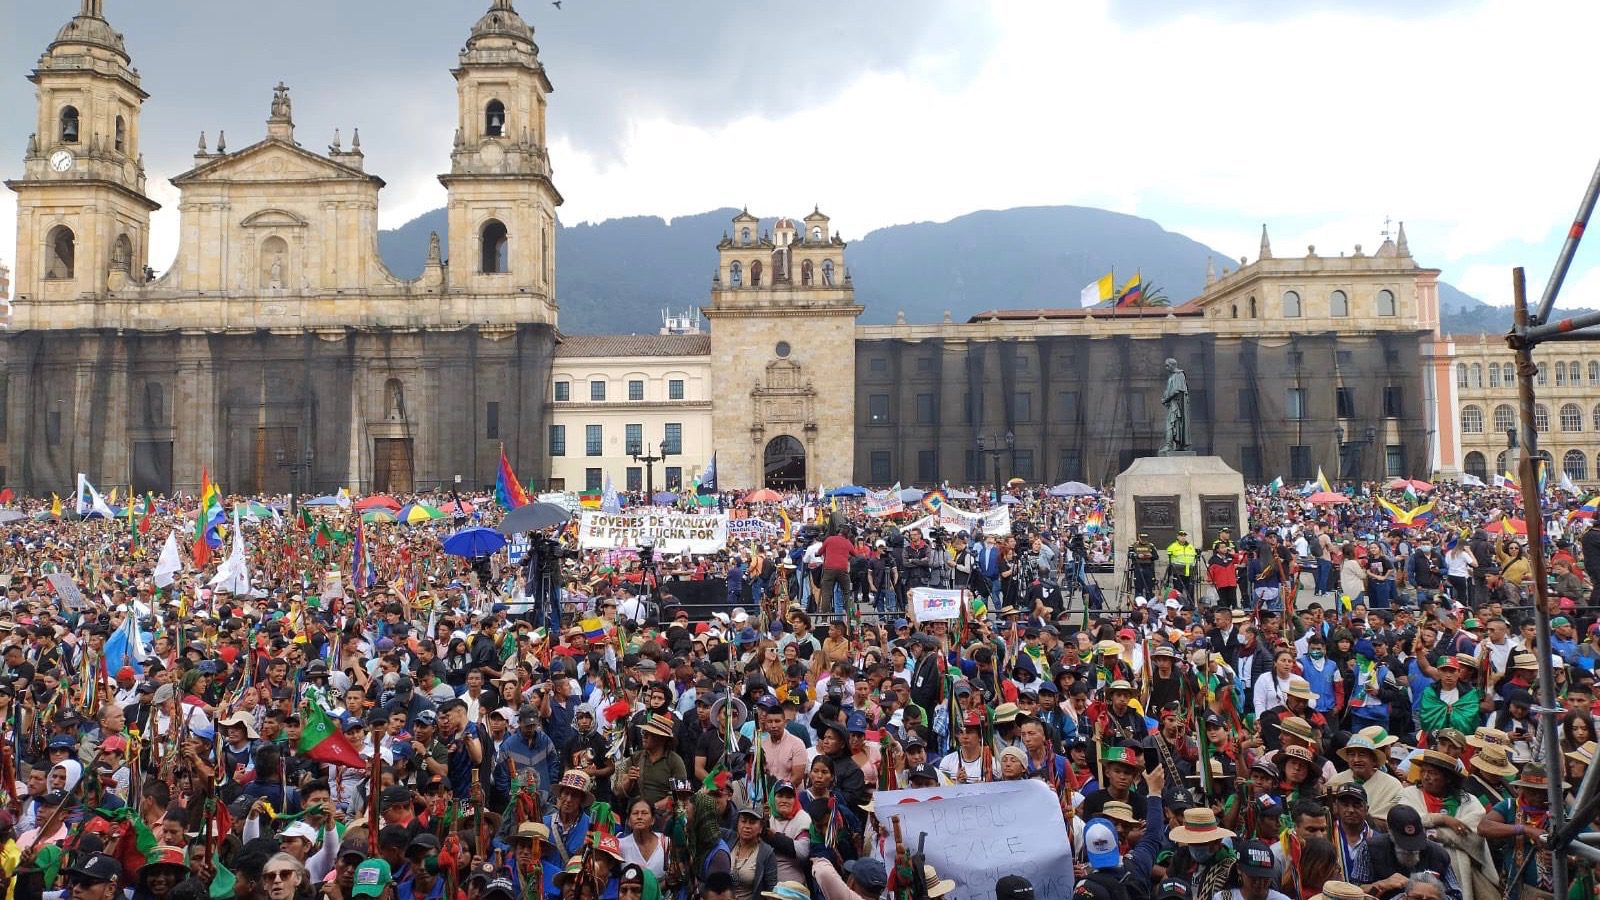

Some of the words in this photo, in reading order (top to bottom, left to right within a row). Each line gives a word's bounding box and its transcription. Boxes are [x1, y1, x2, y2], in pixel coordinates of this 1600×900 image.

[590, 515, 644, 527] JOVENES
[649, 516, 664, 526] DE
[669, 518, 719, 528] YAQUIVA
[589, 527, 605, 538] EN
[608, 528, 629, 538] PIE
[631, 528, 646, 538] DE
[649, 528, 686, 539] LUCHA
[689, 530, 715, 540] POR
